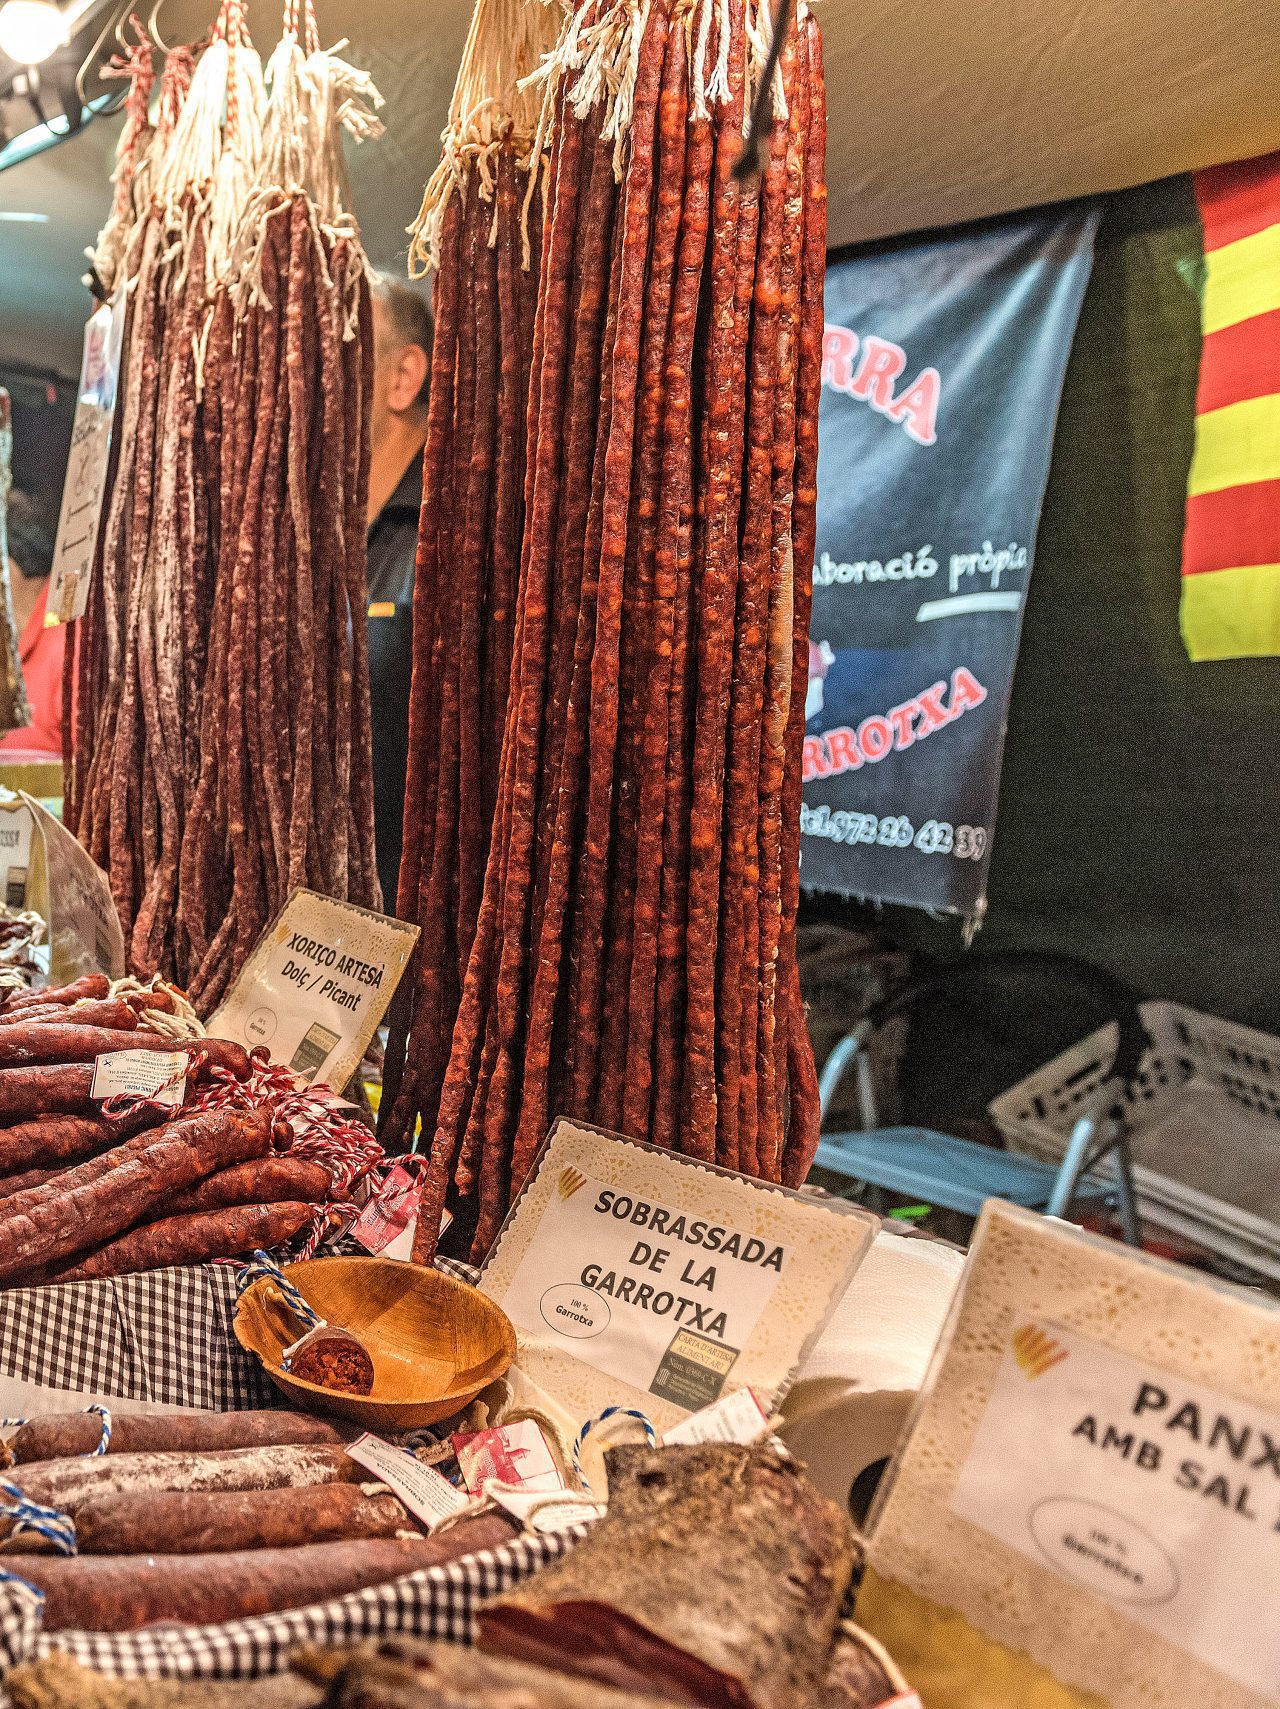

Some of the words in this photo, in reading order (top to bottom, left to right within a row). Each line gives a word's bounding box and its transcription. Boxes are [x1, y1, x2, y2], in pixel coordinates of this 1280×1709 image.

[281, 960, 310, 988] Dolç
[319, 979, 362, 1012] Picant
[286, 932, 337, 967] XORIÇO
[335, 955, 386, 989] ARTESÀ
[593, 1190, 785, 1273] SOBRASSADA
[628, 1241, 671, 1274] DE
[680, 1259, 718, 1292] LA
[555, 1304, 594, 1328] Garrotxa
[580, 1263, 729, 1339] GARROTXA
[678, 1333, 700, 1348] CARTA
[1071, 1413, 1163, 1473] AMB
[1174, 1458, 1258, 1521] SAL
